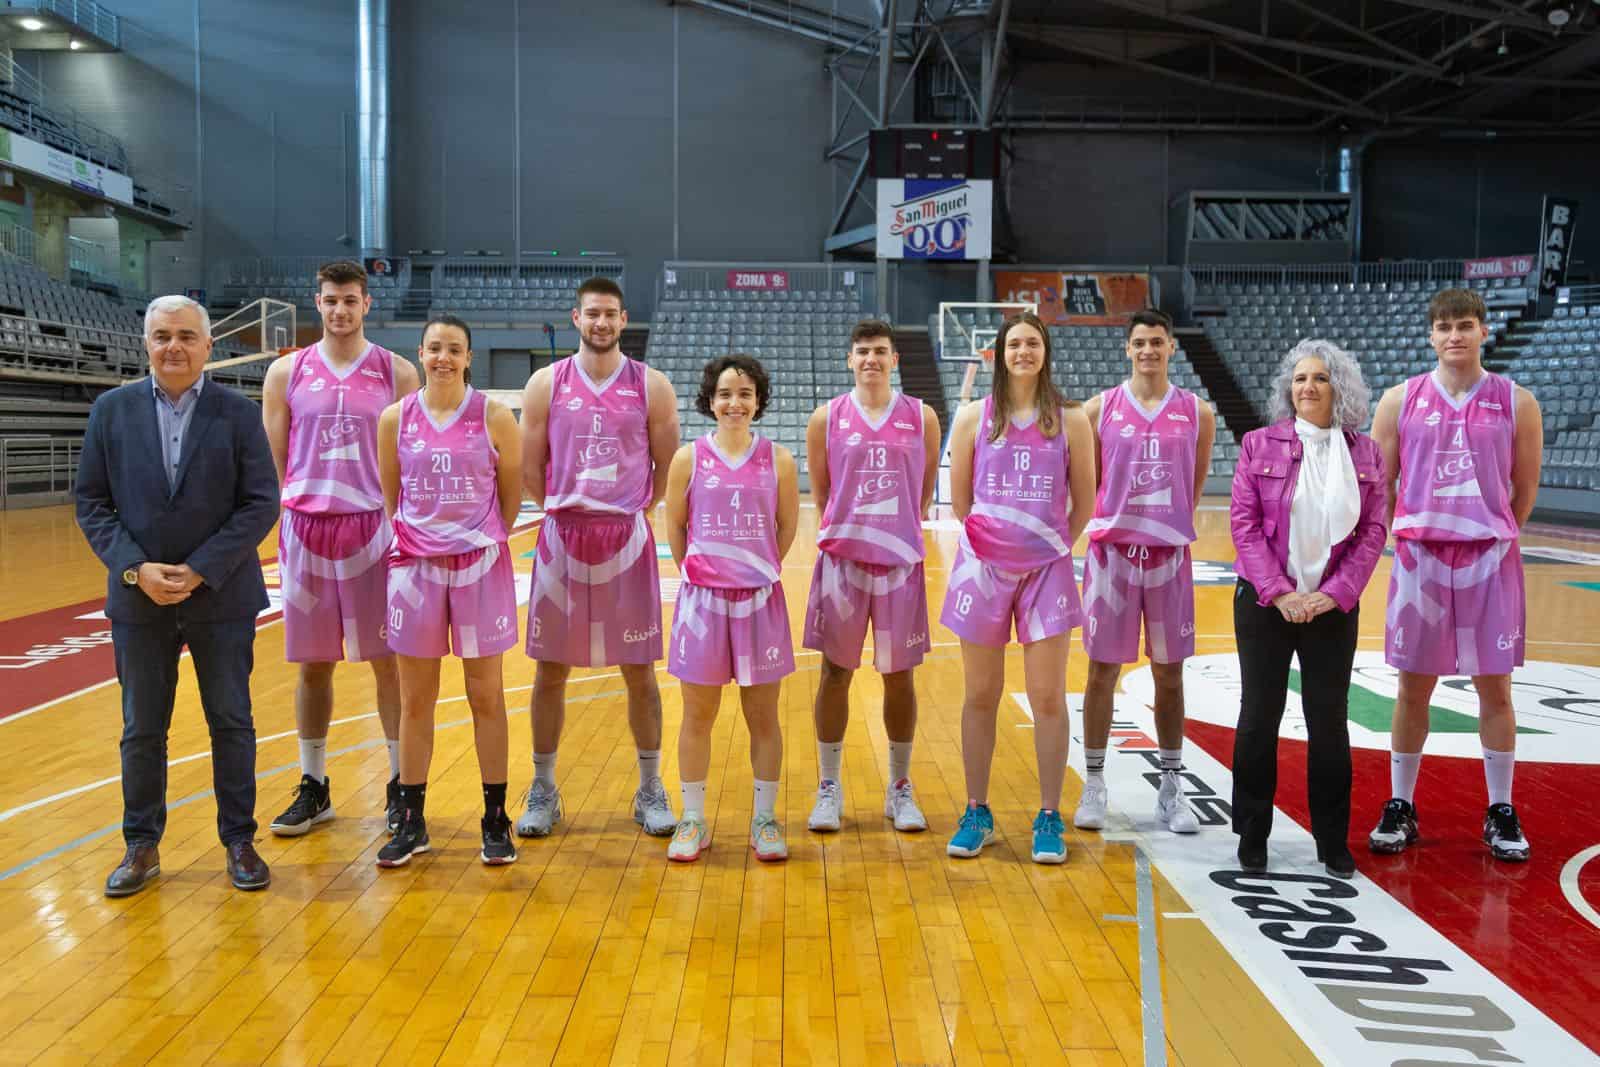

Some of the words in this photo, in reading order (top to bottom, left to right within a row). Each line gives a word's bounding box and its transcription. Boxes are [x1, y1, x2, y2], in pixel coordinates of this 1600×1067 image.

[890, 208, 920, 231] San
[921, 193, 967, 219] Miguel
[1546, 205, 1570, 270] BAR
[1470, 261, 1503, 275] ZONA
[735, 273, 766, 287] ZONA
[1074, 303, 1097, 314] 10
[593, 413, 602, 434] 6
[1452, 426, 1463, 448] 4
[867, 447, 887, 468] 13
[1142, 438, 1160, 459] 10
[431, 453, 451, 473] 20
[1012, 451, 1031, 471] 18
[408, 476, 474, 491] ELITE
[987, 473, 1054, 489] ELITE
[730, 490, 740, 511] 4
[701, 513, 767, 528] ELITE
[955, 590, 973, 615] 18
[532, 616, 542, 638] 6
[1393, 626, 1405, 649] 4
[679, 634, 686, 658] 4
